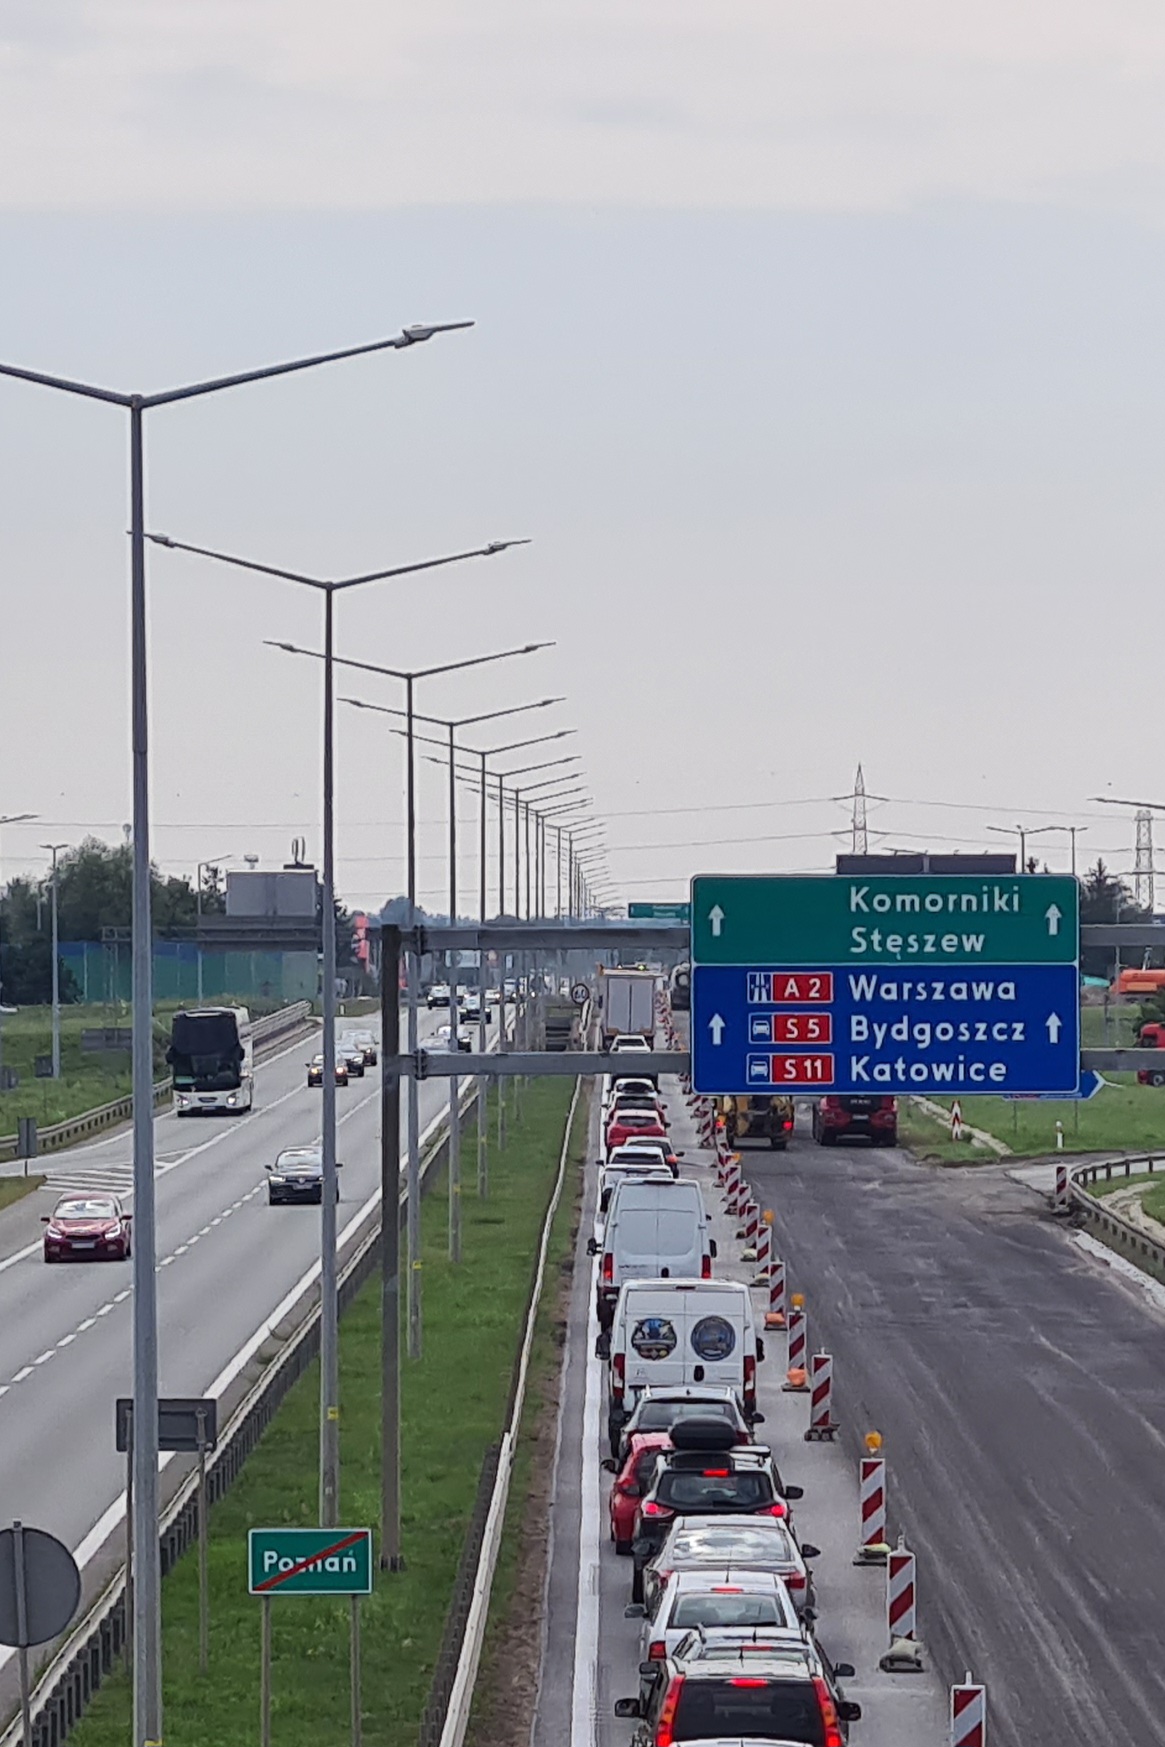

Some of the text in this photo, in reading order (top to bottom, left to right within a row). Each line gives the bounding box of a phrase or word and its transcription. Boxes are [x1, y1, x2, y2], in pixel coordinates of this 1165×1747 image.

[850, 886, 1019, 912] Komorniki
[850, 927, 984, 960] Stęszew
[848, 974, 1016, 1001] Warszawa
[851, 1015, 1025, 1049] Bydgoszcz
[851, 1055, 1007, 1082] Katowice
